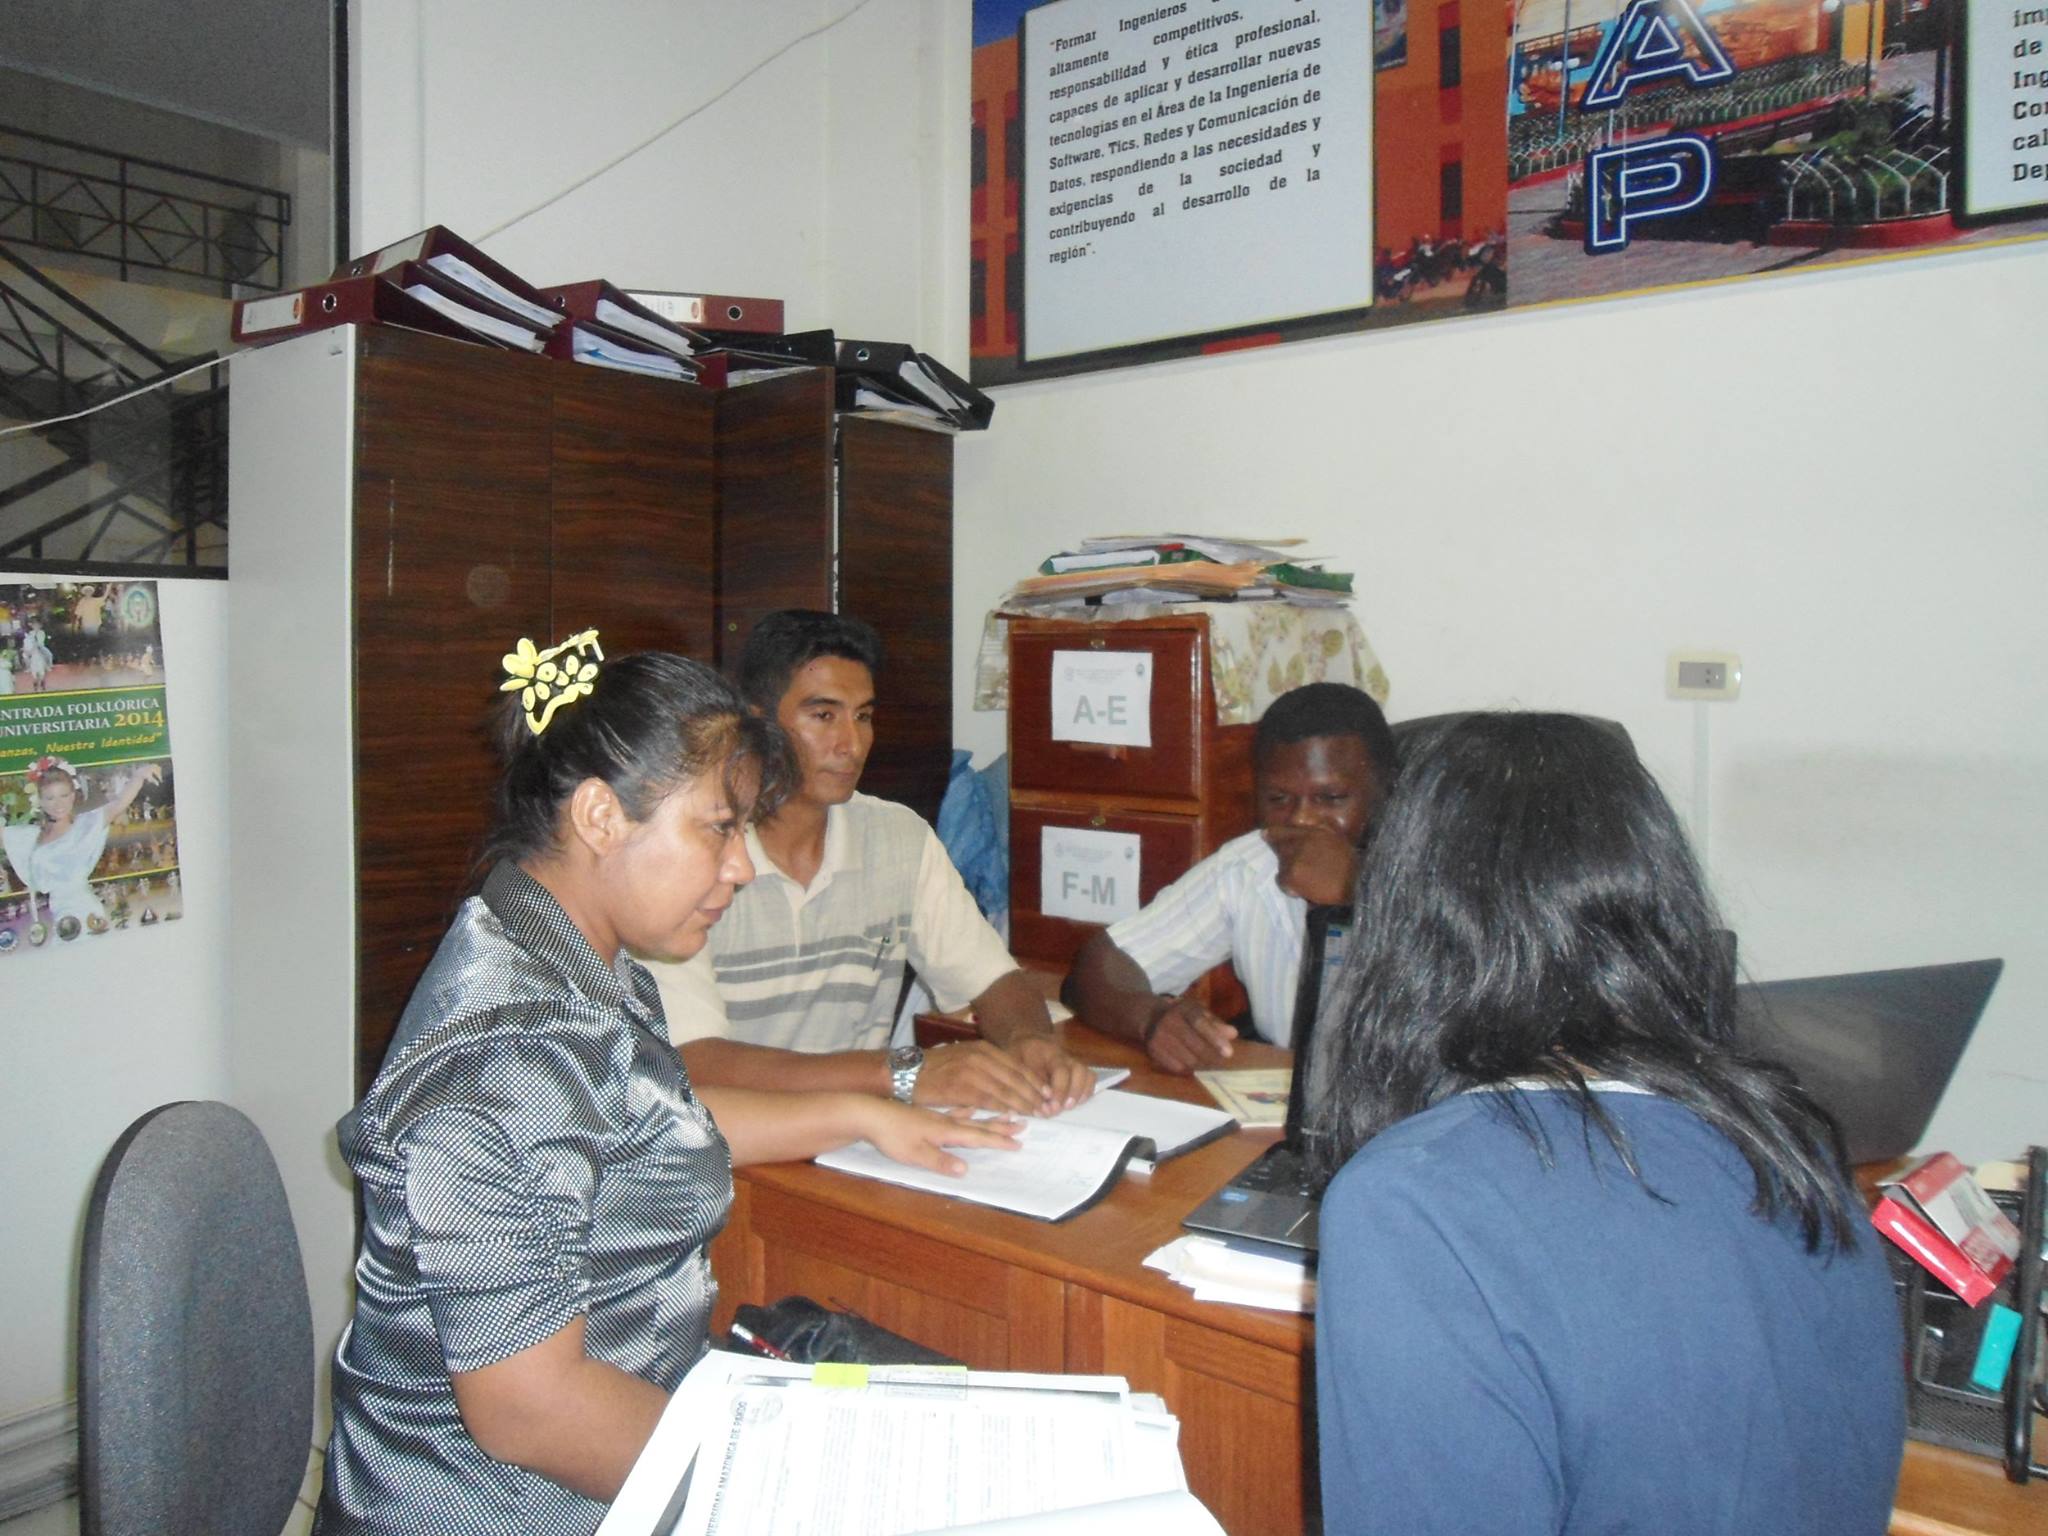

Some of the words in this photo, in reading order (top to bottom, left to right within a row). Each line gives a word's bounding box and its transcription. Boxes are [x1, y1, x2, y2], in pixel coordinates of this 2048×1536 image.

[1119, 2, 1188, 32] Ingenieros
[2014, 9, 2048, 27] im
[1049, 50, 1109, 77] altamente
[2014, 39, 2043, 58] de
[1049, 59, 1147, 101] responsabilidad
[1161, 55, 1170, 70] y
[1185, 41, 1219, 60] ética
[1049, 101, 1098, 124] capaces
[1103, 95, 1119, 109] de
[1124, 81, 1169, 104] aplicar
[1173, 77, 1183, 92] y
[1187, 54, 1263, 85] desarrollar
[1268, 37, 1321, 62] nuevas
[1122, 115, 1137, 128] en
[1141, 108, 1152, 123] el
[1189, 93, 1205, 109] de
[1209, 90, 1222, 104] la
[1226, 69, 1299, 100] Ingeniería
[1303, 63, 1321, 78] de
[2014, 101, 2048, 119] Co
[1143, 125, 1183, 147] Redes
[1187, 123, 1195, 139] y
[1198, 94, 1299, 132] Comunicación
[1303, 89, 1321, 104] de
[1090, 152, 1176, 184] respondiendo
[1180, 150, 1189, 162] a
[1193, 143, 1214, 159] las
[1218, 120, 1308, 152] necesidades
[1312, 116, 1322, 132] y
[1049, 193, 1114, 217] exigencias
[1138, 182, 1154, 197] de
[1179, 172, 1193, 187] la
[1219, 148, 1283, 177] sociedad
[1311, 142, 1322, 158] y
[2013, 163, 2048, 182] De
[1049, 210, 1136, 240] contribuyendo
[1152, 202, 1165, 217] al
[1182, 184, 1251, 211] desarrollo
[1269, 175, 1287, 191] de
[1306, 168, 1321, 183] la
[1585, 134, 1717, 254] P
[67, 698, 160, 715] FOLKLÓRICA
[114, 710, 165, 728] 2014
[1073, 695, 1127, 725] A-E
[1063, 872, 1115, 906] F-M
